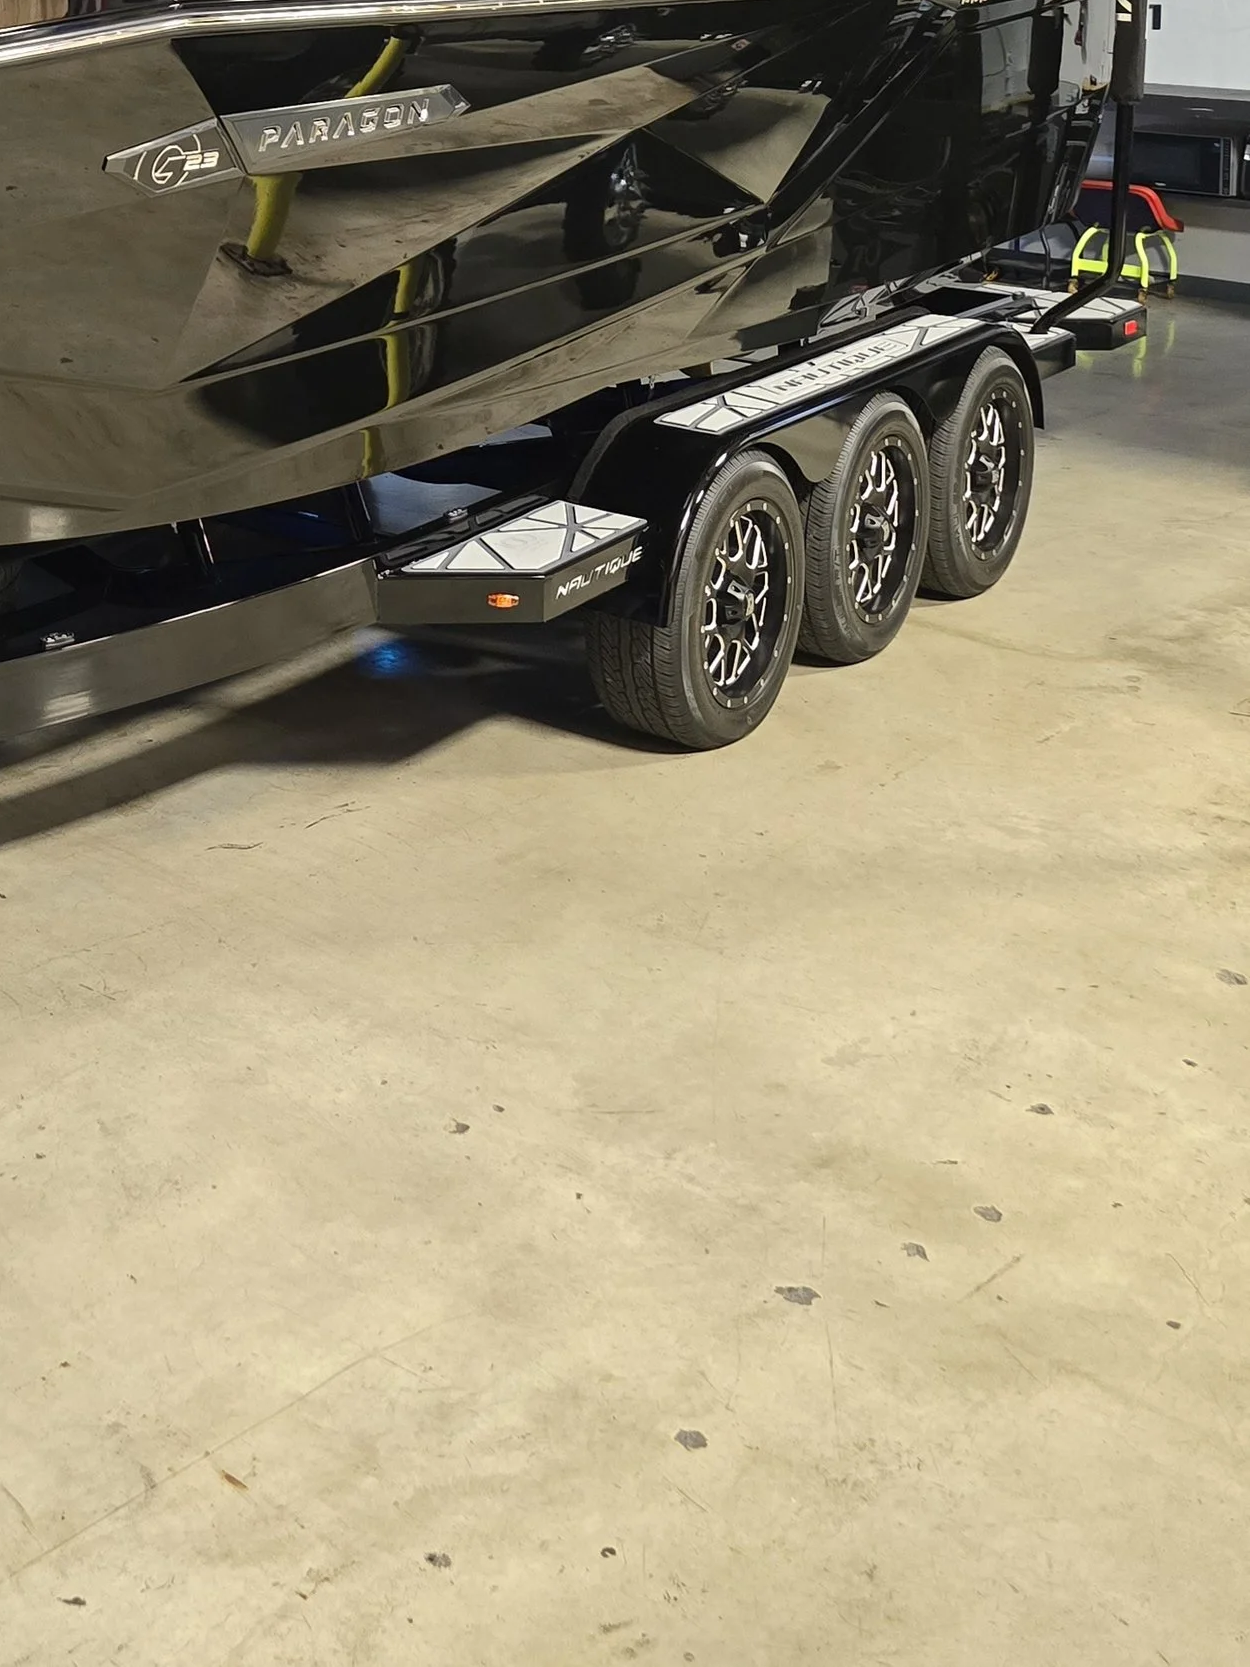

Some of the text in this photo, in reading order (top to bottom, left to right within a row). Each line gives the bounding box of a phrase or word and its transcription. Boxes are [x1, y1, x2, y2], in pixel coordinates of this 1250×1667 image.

[257, 98, 430, 153] PARAGON
[772, 340, 898, 392] NAUTIQUE
[555, 546, 643, 600] NAUTIQUE
